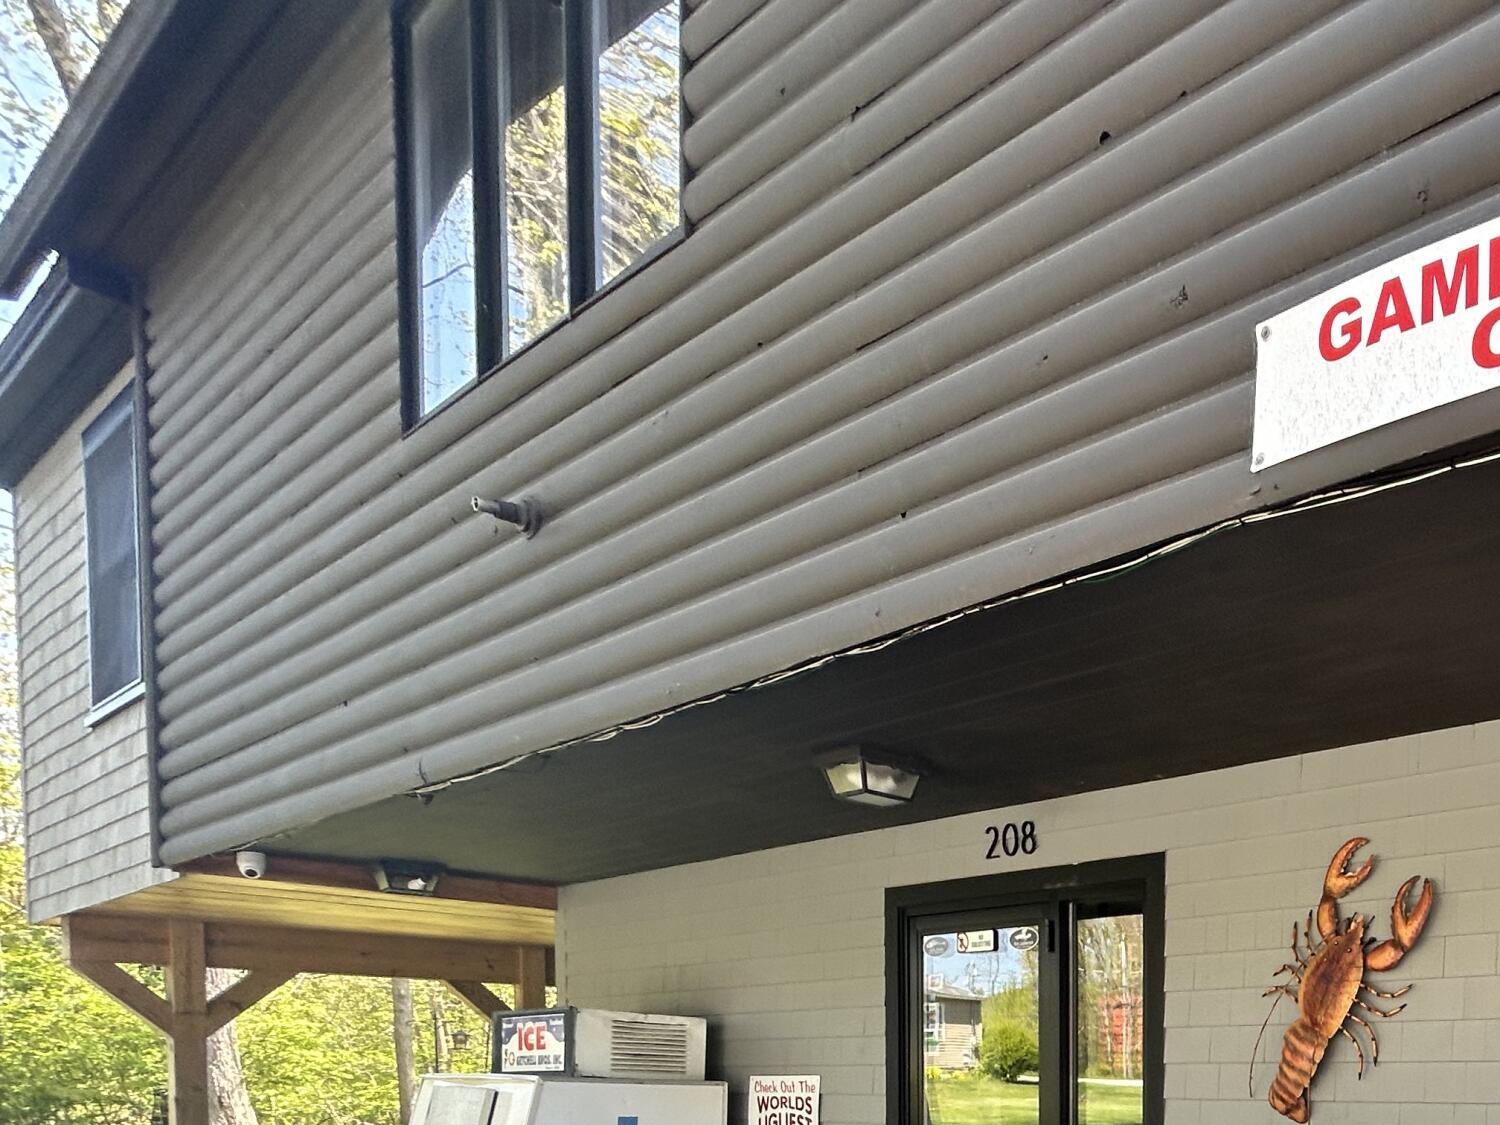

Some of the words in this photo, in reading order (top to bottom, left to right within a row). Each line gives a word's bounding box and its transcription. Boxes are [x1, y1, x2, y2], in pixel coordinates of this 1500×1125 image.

[985, 820, 1037, 860] 208
[517, 1025, 547, 1051] ICE
[754, 1080, 778, 1094] Check
[780, 1080, 796, 1094] Out
[798, 1080, 816, 1094] The
[757, 1095, 813, 1115] WORLDS
